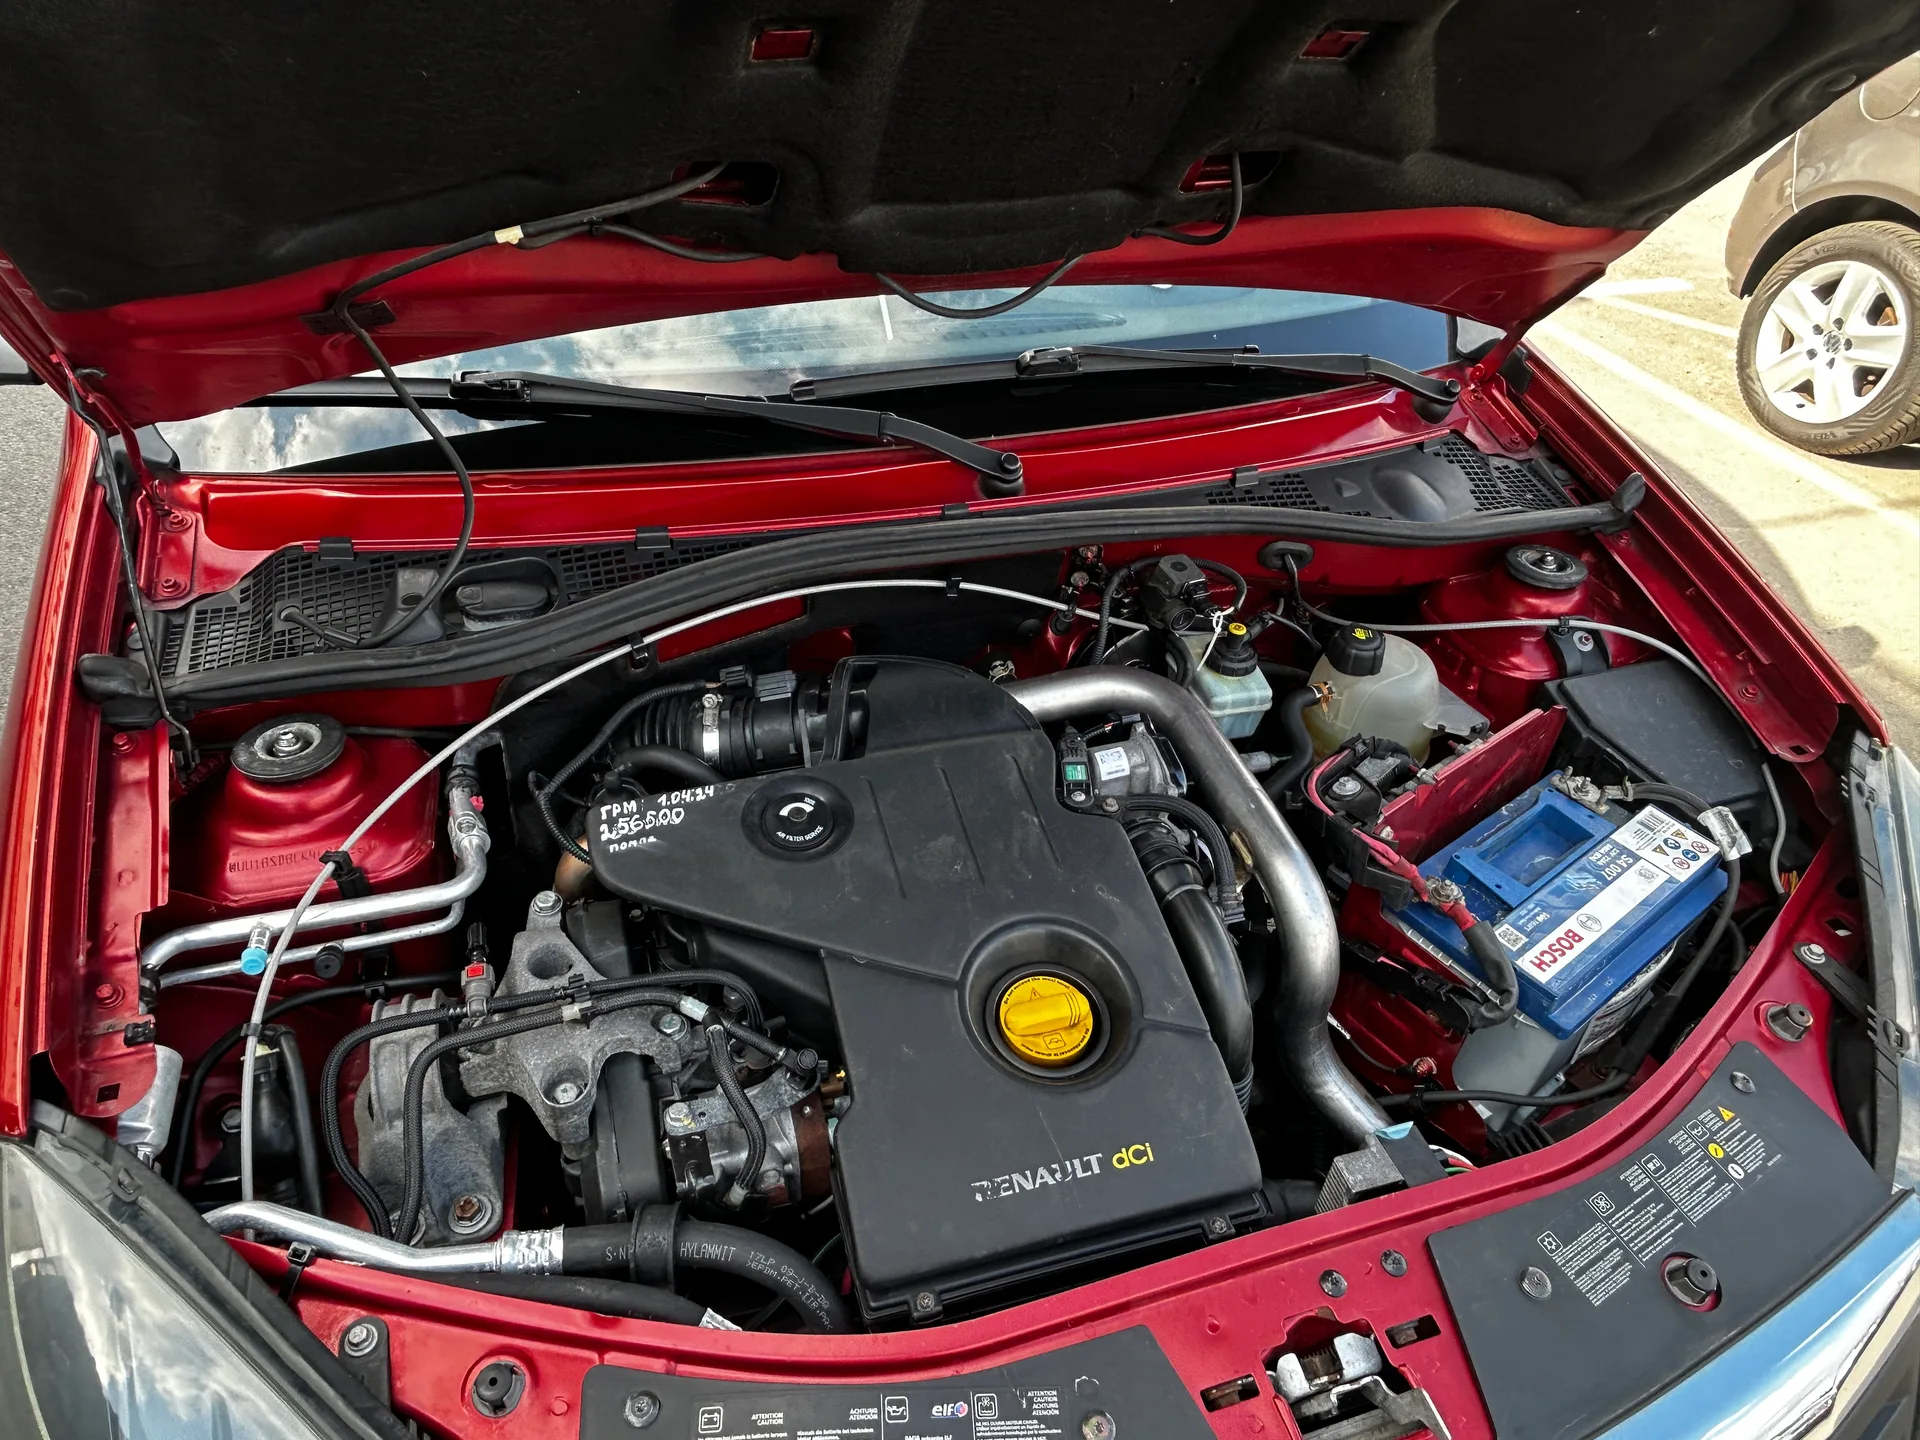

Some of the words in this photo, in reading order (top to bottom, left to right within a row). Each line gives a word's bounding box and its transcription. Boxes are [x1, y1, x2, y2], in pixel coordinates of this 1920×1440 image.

[1601, 864, 1621, 880] 007
[1529, 929, 1584, 972] BOSCH
[971, 1153, 1102, 1202] RENAULT
[1112, 1143, 1154, 1169] dCi
